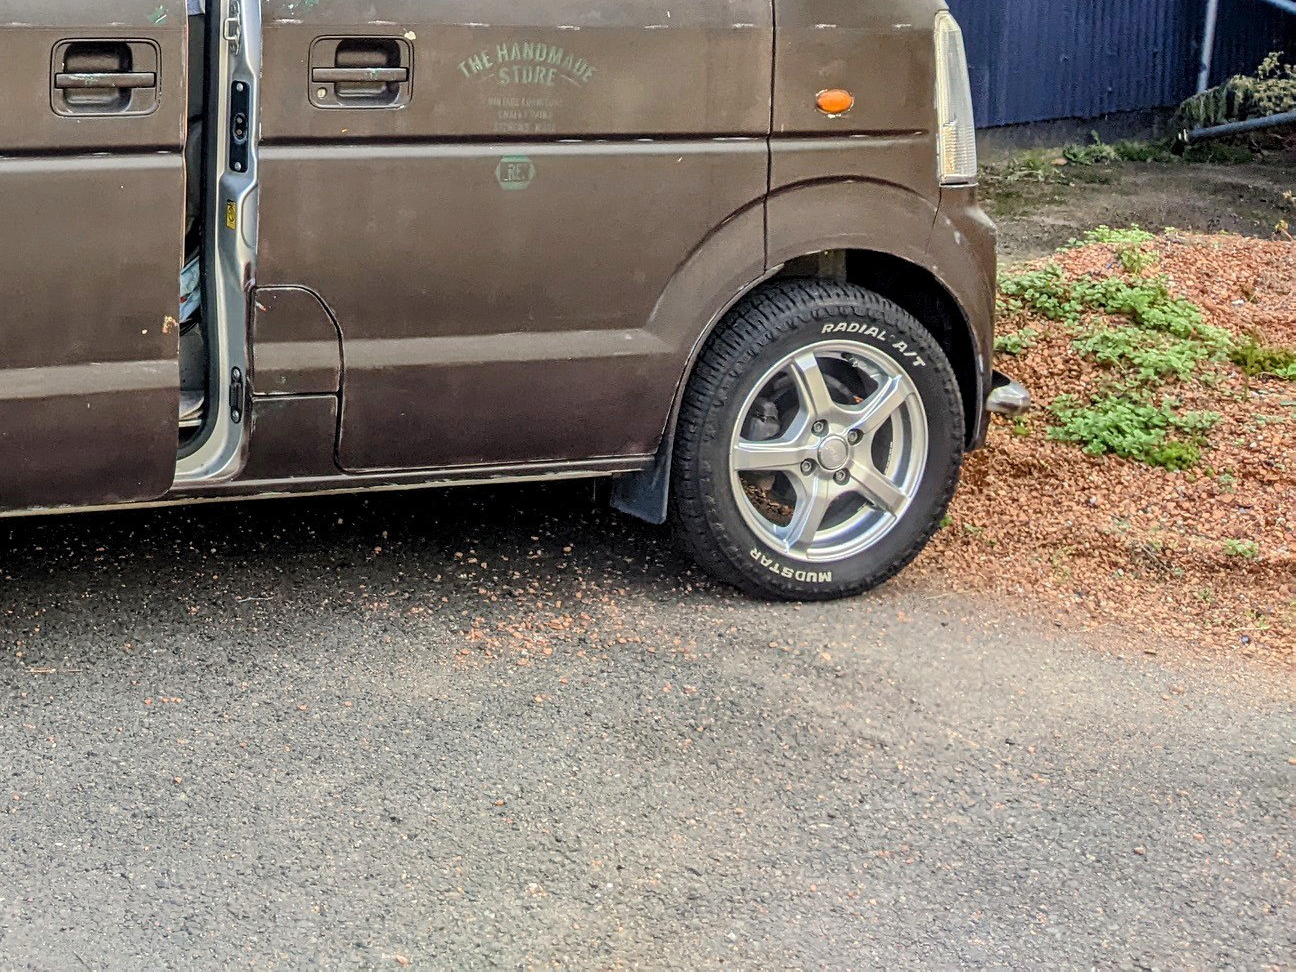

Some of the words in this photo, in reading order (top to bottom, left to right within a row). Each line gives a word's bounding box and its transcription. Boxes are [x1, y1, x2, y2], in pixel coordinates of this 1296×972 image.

[458, 49, 494, 79] THE
[496, 42, 599, 84] HANDMADE
[498, 64, 558, 86] STORE
[821, 322, 888, 343] RADIAL
[892, 339, 927, 369] A/T
[750, 546, 832, 583] MUDSTAR
